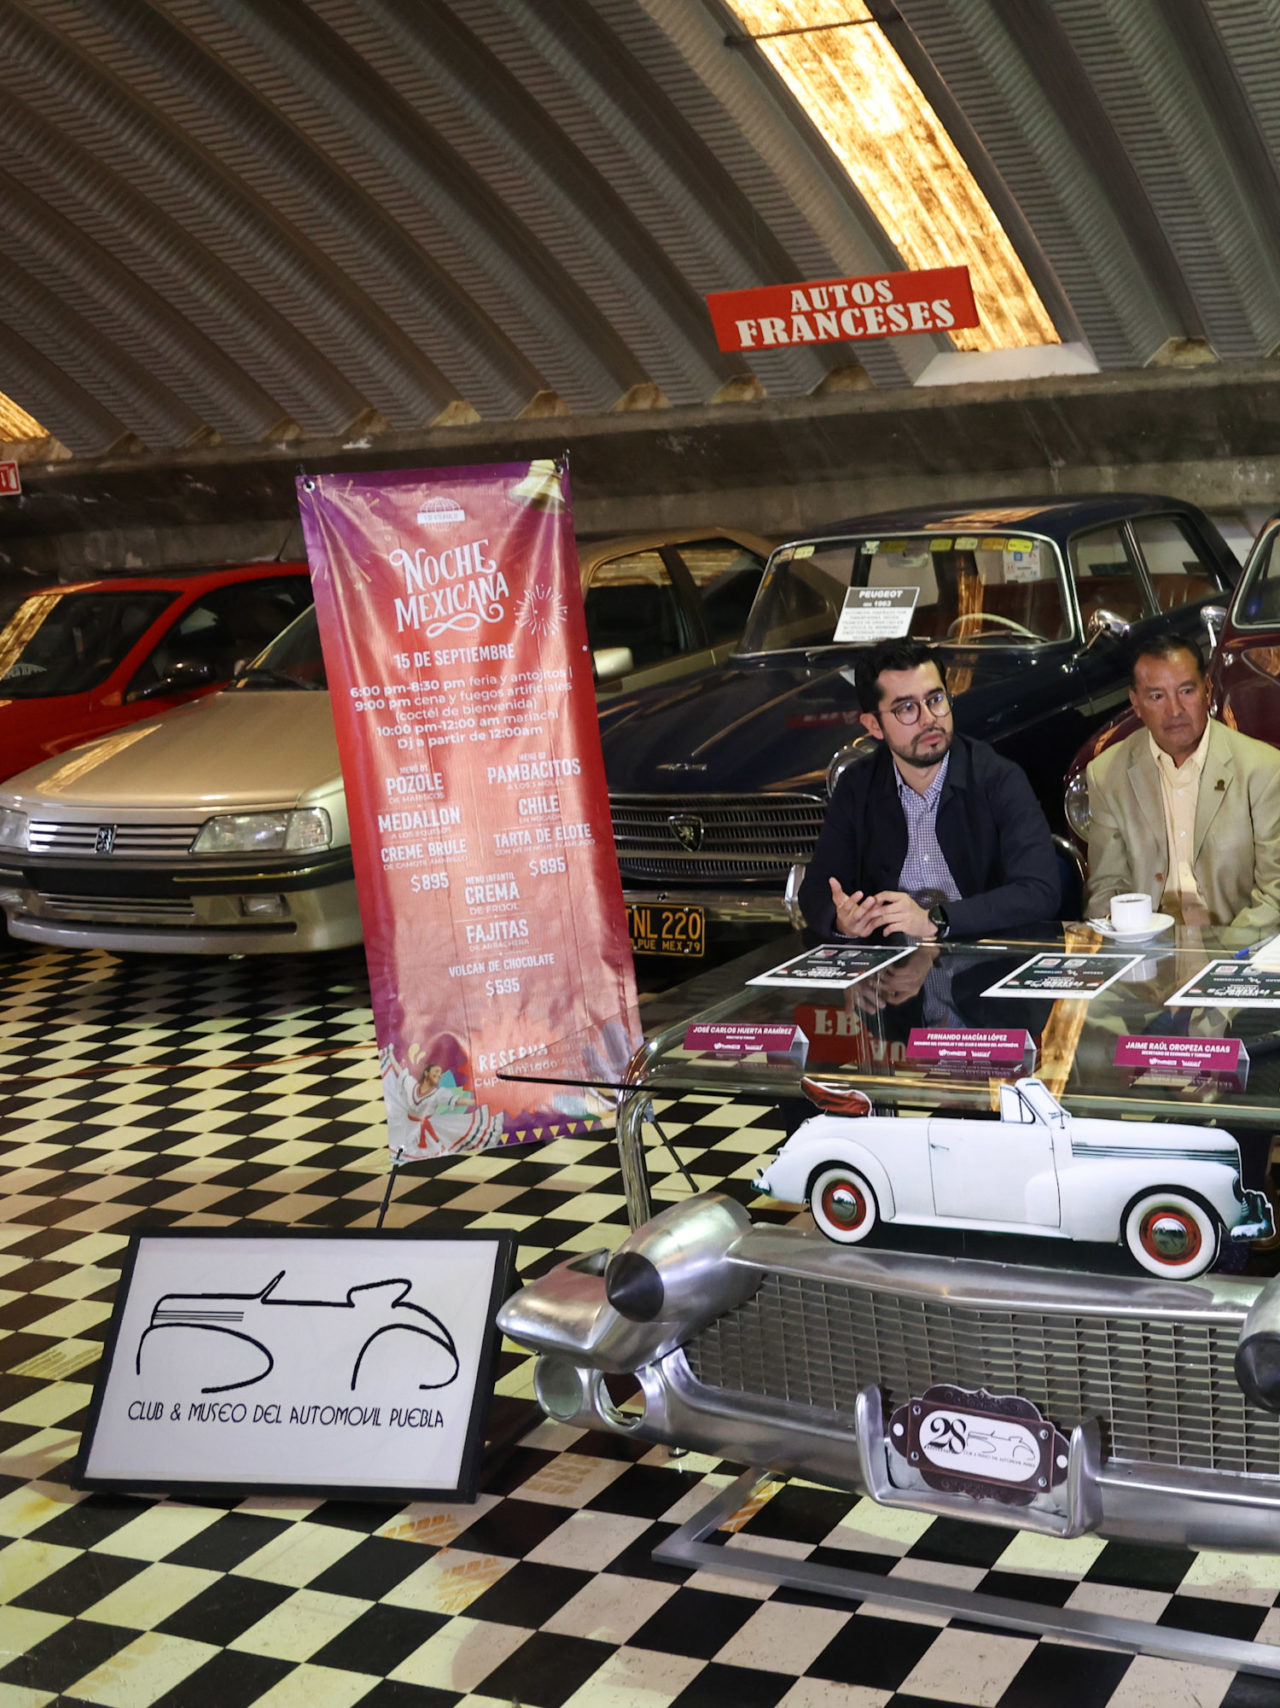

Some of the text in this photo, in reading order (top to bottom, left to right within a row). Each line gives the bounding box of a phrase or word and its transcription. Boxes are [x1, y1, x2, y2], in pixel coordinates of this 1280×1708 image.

[791, 280, 894, 312] AUTOS
[735, 299, 955, 348] FRANCESES
[389, 539, 497, 594] NOCHE
[394, 572, 509, 632] MEXICANA
[394, 643, 516, 669] 15 DE SEPTIEMBRE
[350, 668, 566, 698] 6:00 pm-8:30 pm feria y antojitos
[355, 682, 573, 712] 9:00 pm cena y fuegos artificiales
[442, 704, 459, 717] de
[462, 699, 538, 715] bienvenida)
[376, 710, 559, 737] 10:00 pm-12:00 am mariachi
[398, 726, 543, 750] Dj a partir de 12:00am
[487, 758, 582, 784] PAMBACITOS
[386, 772, 444, 796] POZOLE
[519, 795, 560, 816] CHILE
[378, 806, 461, 833] MEDALLON
[494, 824, 592, 848] TARTA DE ELOTE
[381, 839, 467, 863] CREME BRULE
[486, 872, 515, 882] INFANTIL
[529, 857, 567, 877] $895
[411, 872, 449, 893] $895
[465, 881, 521, 905] CREMA
[470, 906, 483, 915] DE
[466, 918, 529, 944] FAJITAS
[662, 912, 700, 939] 220
[638, 939, 656, 950] PUE
[662, 941, 683, 951] MEX
[449, 953, 555, 978] VOLCAN DE CHOCOLATE
[486, 978, 520, 997] $595
[693, 1026, 710, 1034] JOSÉ
[737, 1027, 762, 1035] HUERTA
[763, 1027, 793, 1035] RAMÍREZ
[962, 1033, 987, 1041] MACÍAS
[988, 1033, 1008, 1042] LÓPEZ
[1125, 1042, 1231, 1053] JAIME RAÚL OROPEZA CASAS
[128, 1401, 444, 1428] CLUB & MUSEO DEL AUTOMOVIL PUEBLA
[924, 1417, 967, 1455] 28
